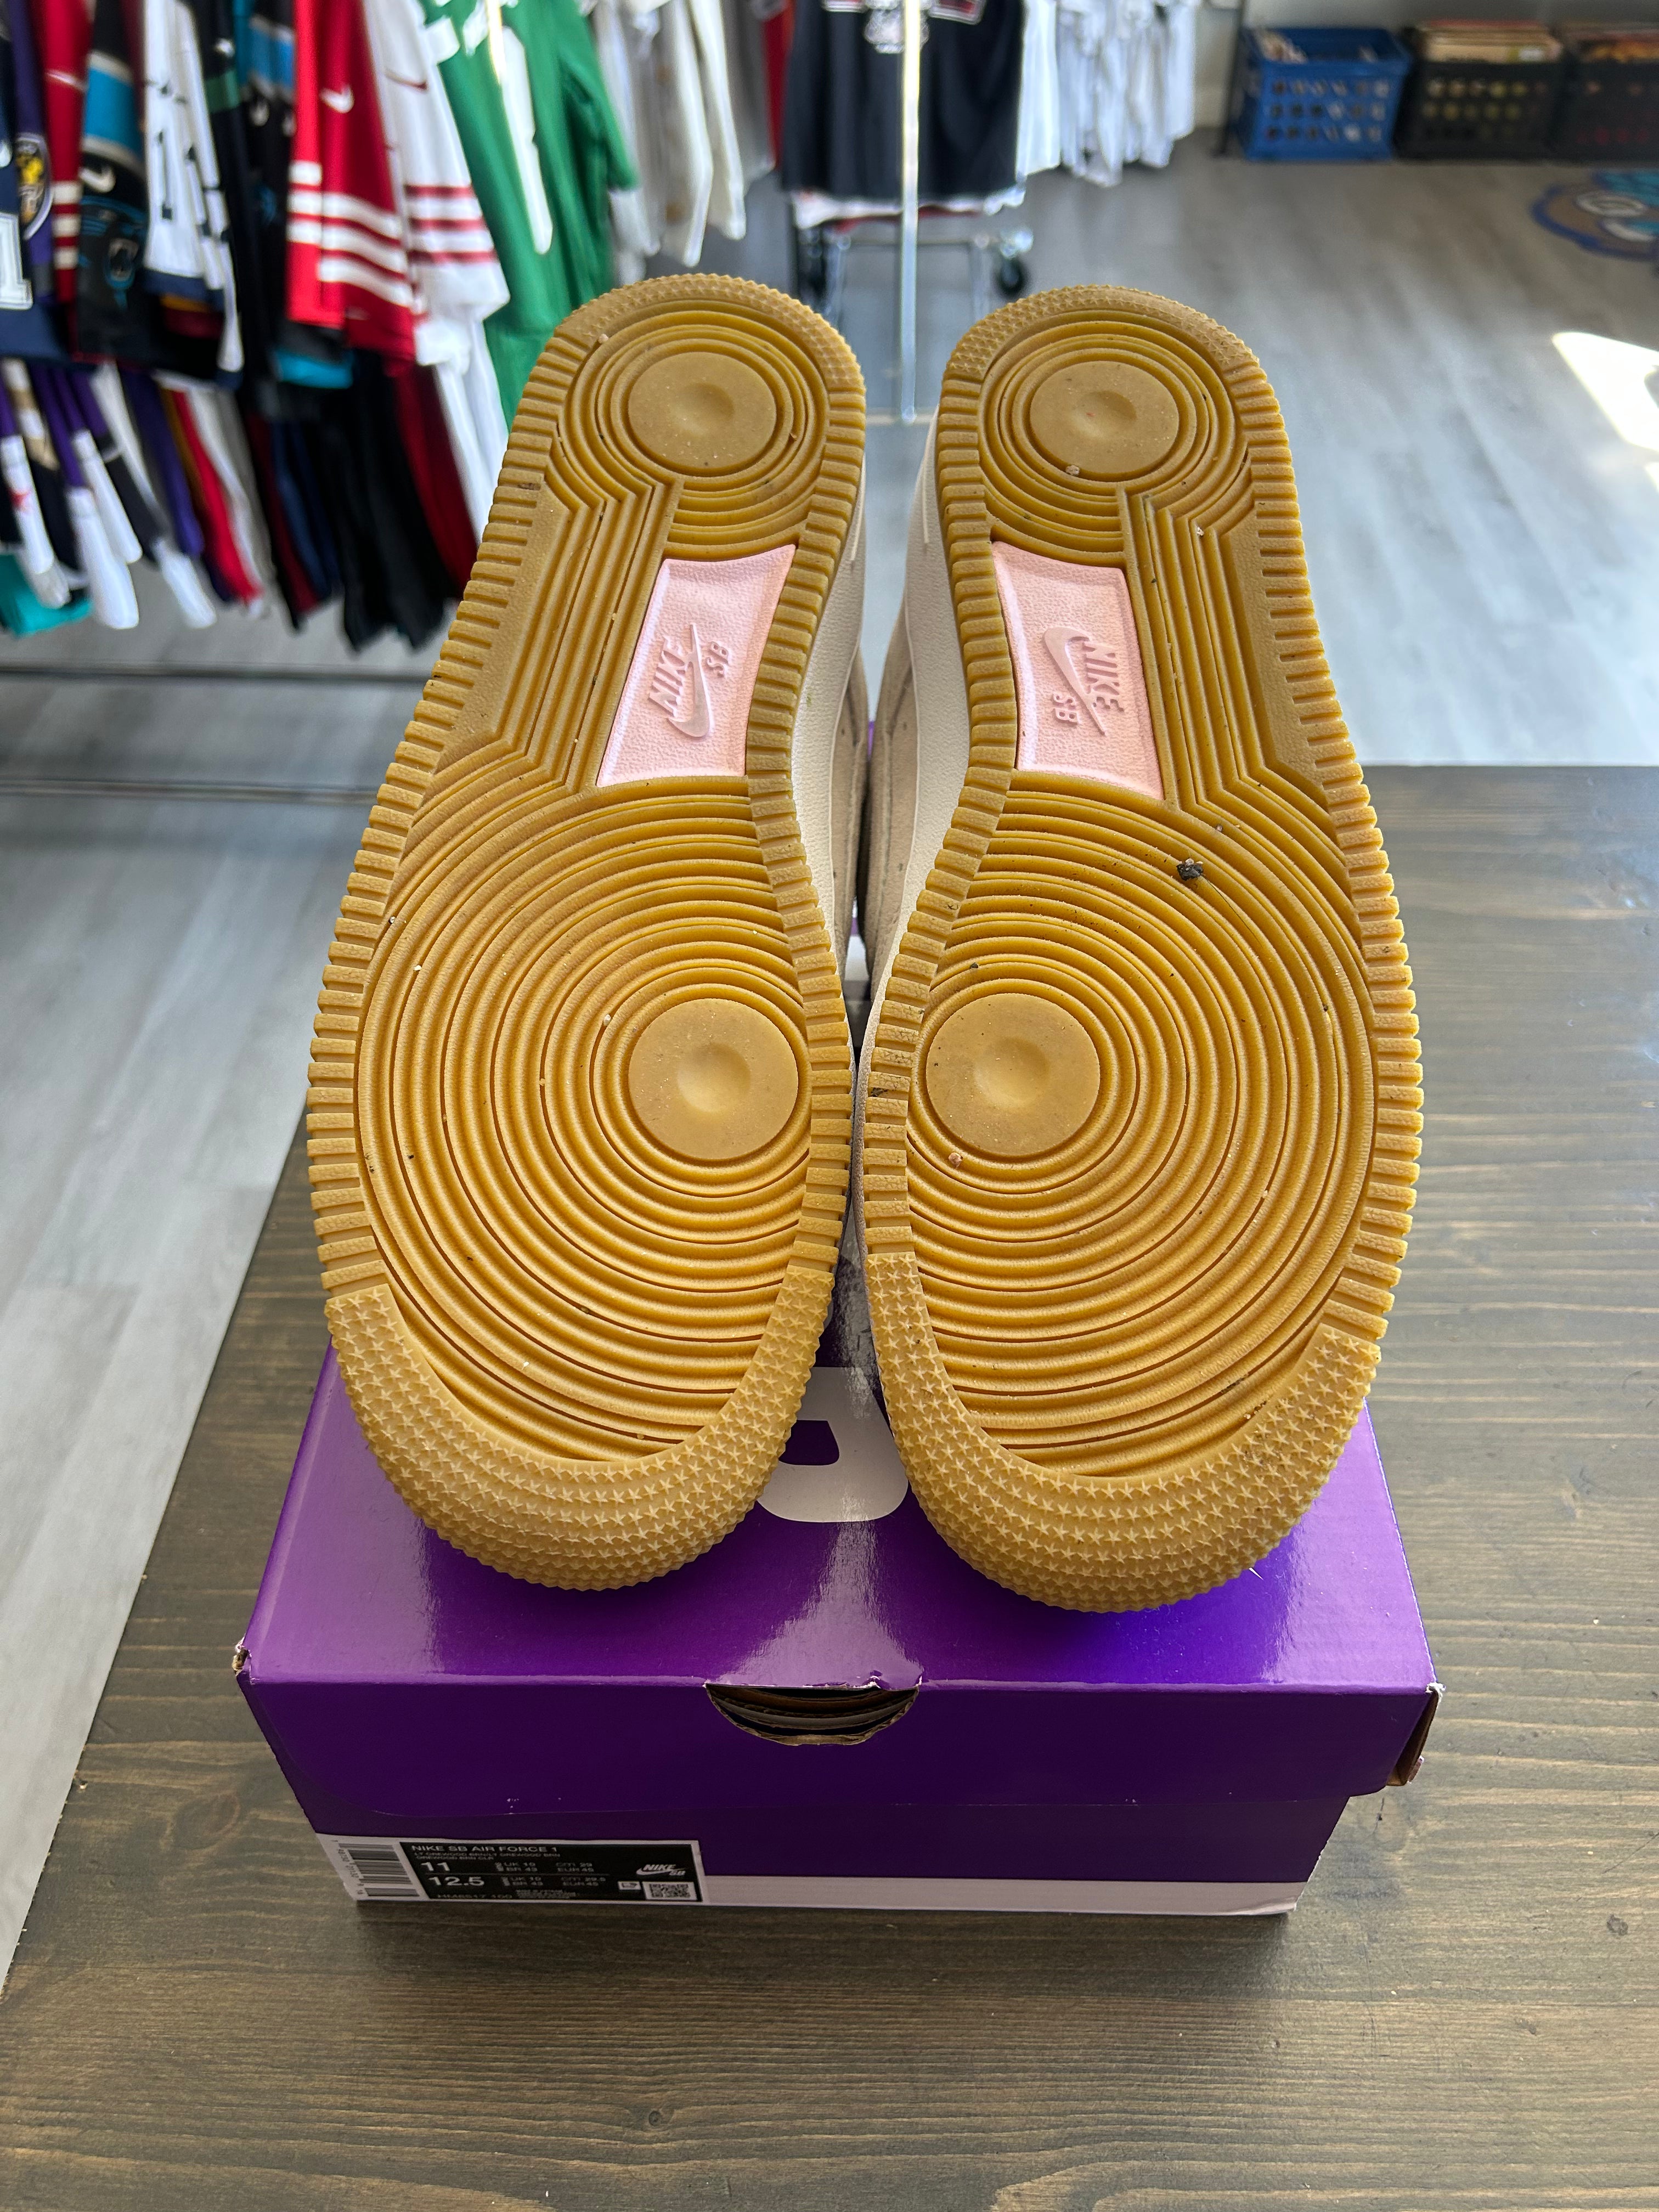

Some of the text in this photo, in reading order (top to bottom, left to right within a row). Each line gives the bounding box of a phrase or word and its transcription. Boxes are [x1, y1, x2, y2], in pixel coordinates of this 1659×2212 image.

[648, 635, 689, 716] NIKE
[707, 641, 729, 678] SB
[1083, 641, 1124, 712] NIKE
[1053, 693, 1079, 727] SB
[421, 1861, 450, 1871] 11
[428, 1876, 484, 1886] 12.5
